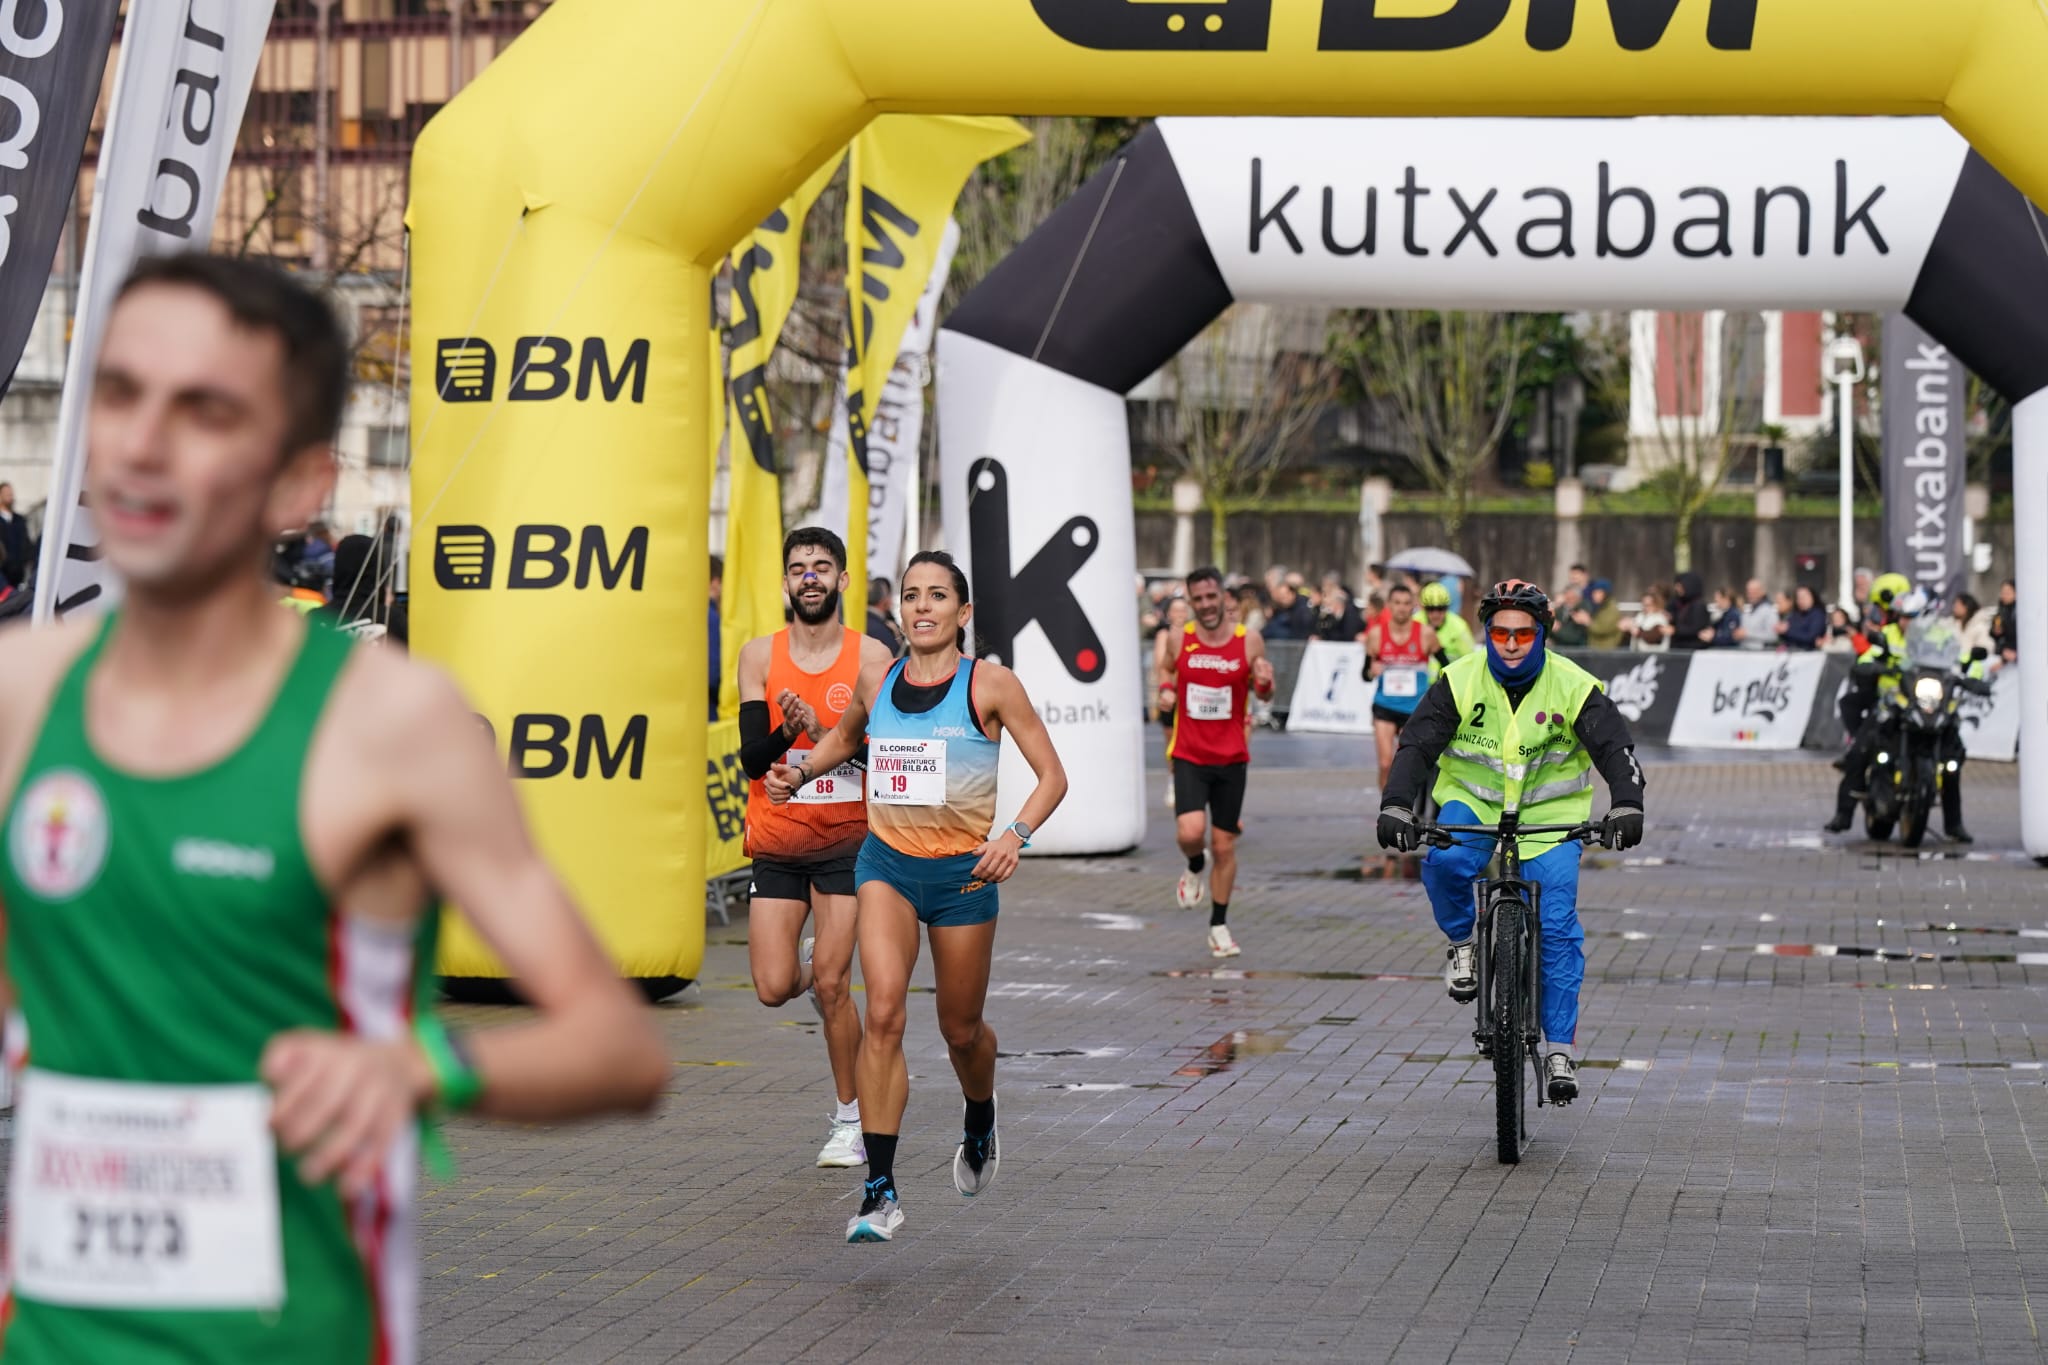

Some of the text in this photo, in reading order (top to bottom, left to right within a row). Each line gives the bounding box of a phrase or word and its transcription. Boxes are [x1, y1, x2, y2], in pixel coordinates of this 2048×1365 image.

[1247, 157, 1892, 259] kutxabank
[507, 335, 651, 404] BM
[1903, 342, 1950, 594] utxabank
[506, 524, 650, 591] BM
[1470, 702, 1486, 728] 2
[932, 726, 966, 737] HOKA
[507, 713, 649, 780] BM
[879, 744, 925, 753] EL CORREO
[902, 758, 937, 766] SANTURCE
[902, 764, 937, 772] BILBAO
[816, 779, 834, 794] 88
[890, 775, 907, 792] 19
